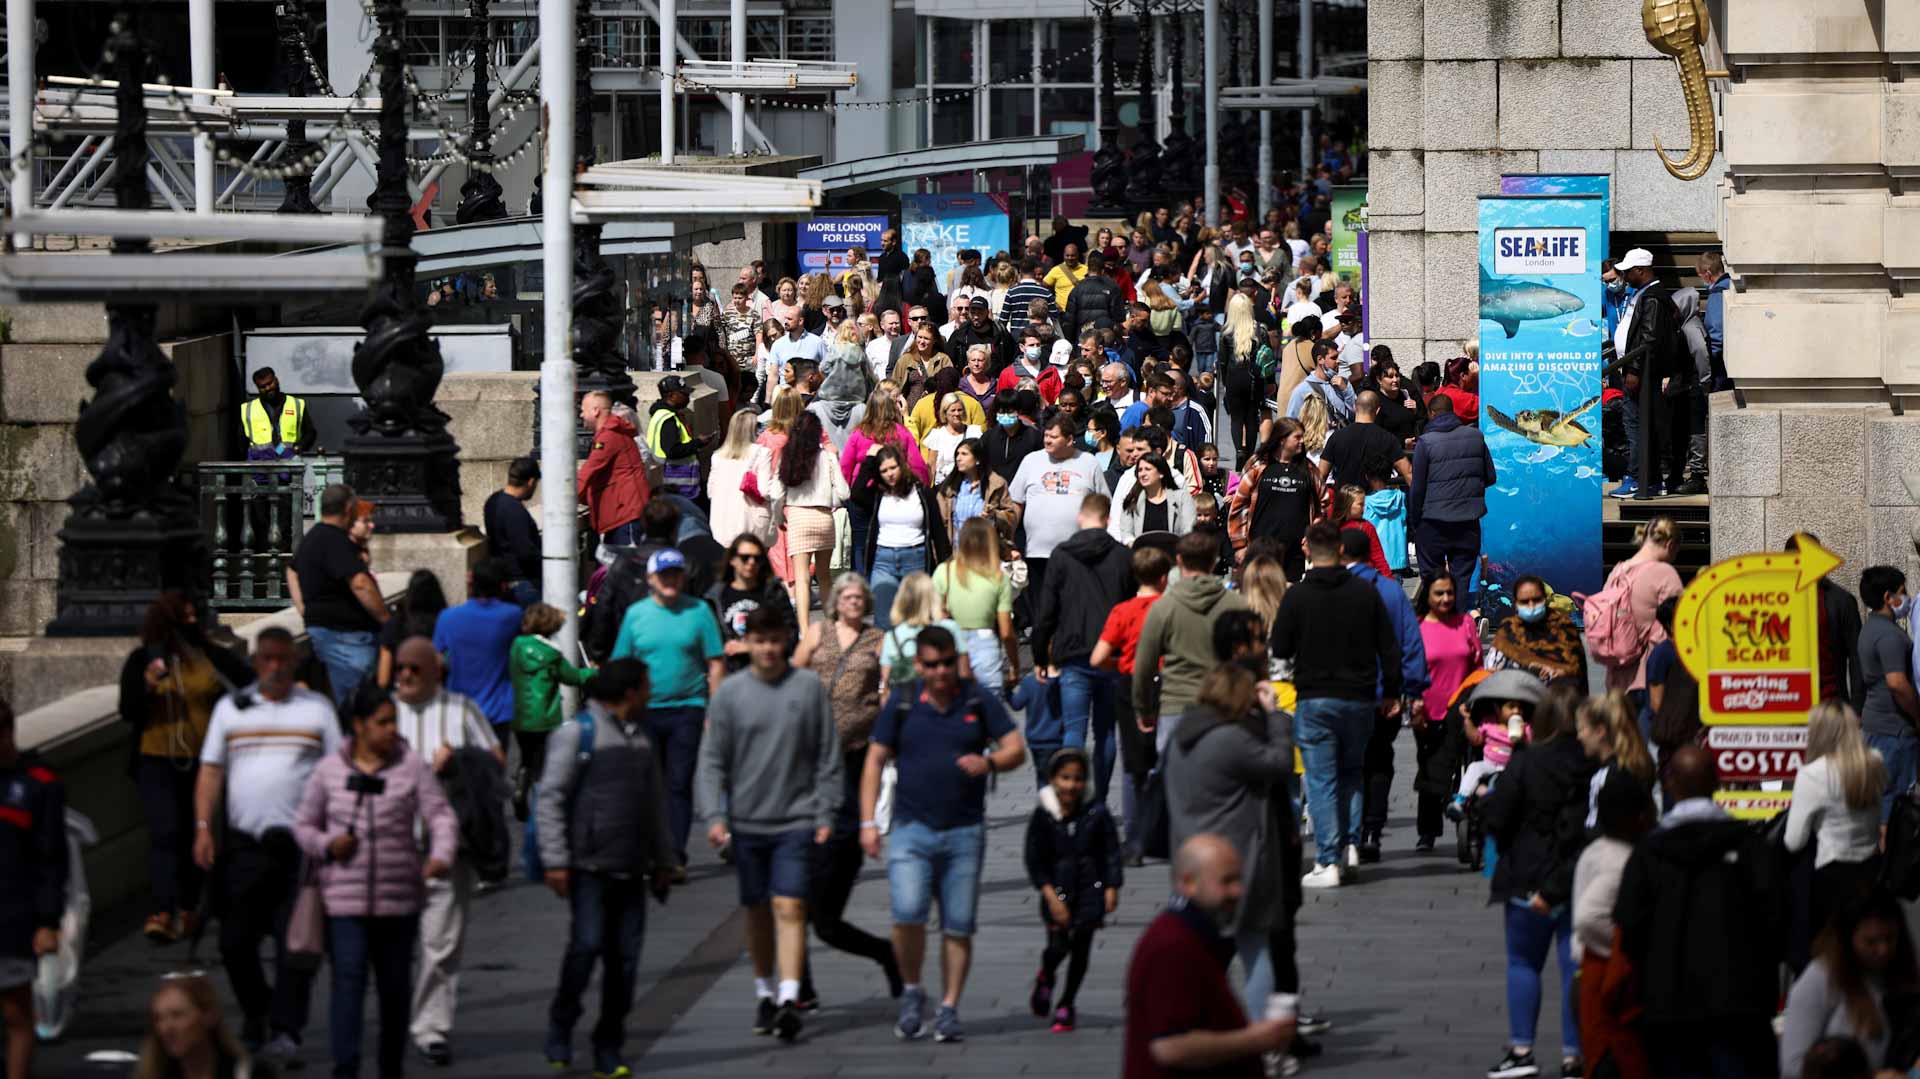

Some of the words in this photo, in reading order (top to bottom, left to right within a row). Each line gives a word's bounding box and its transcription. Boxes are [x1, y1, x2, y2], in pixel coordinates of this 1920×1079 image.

[807, 223, 836, 232] MORE
[838, 223, 881, 232] LONDON
[906, 224, 970, 243] TAKE
[823, 234, 843, 243] FOR
[844, 233, 866, 243] LESS
[1500, 236, 1538, 257] SEA
[1525, 259, 1555, 267] London
[1485, 352, 1507, 360] DIVE
[1511, 352, 1534, 360] INTO
[1537, 352, 1544, 360] A
[1547, 352, 1581, 360] WORLD
[1584, 352, 1598, 360] OF
[1483, 363, 1534, 371] AMAZING
[1538, 362, 1600, 371] DISCOVERY
[1724, 591, 1790, 606] NAMCO
[1727, 647, 1791, 662] SCAPE
[1720, 675, 1789, 691] Bowling
[1713, 731, 1753, 743] PROUD
[1756, 731, 1770, 743] TO
[1717, 750, 1803, 774] COSTA
